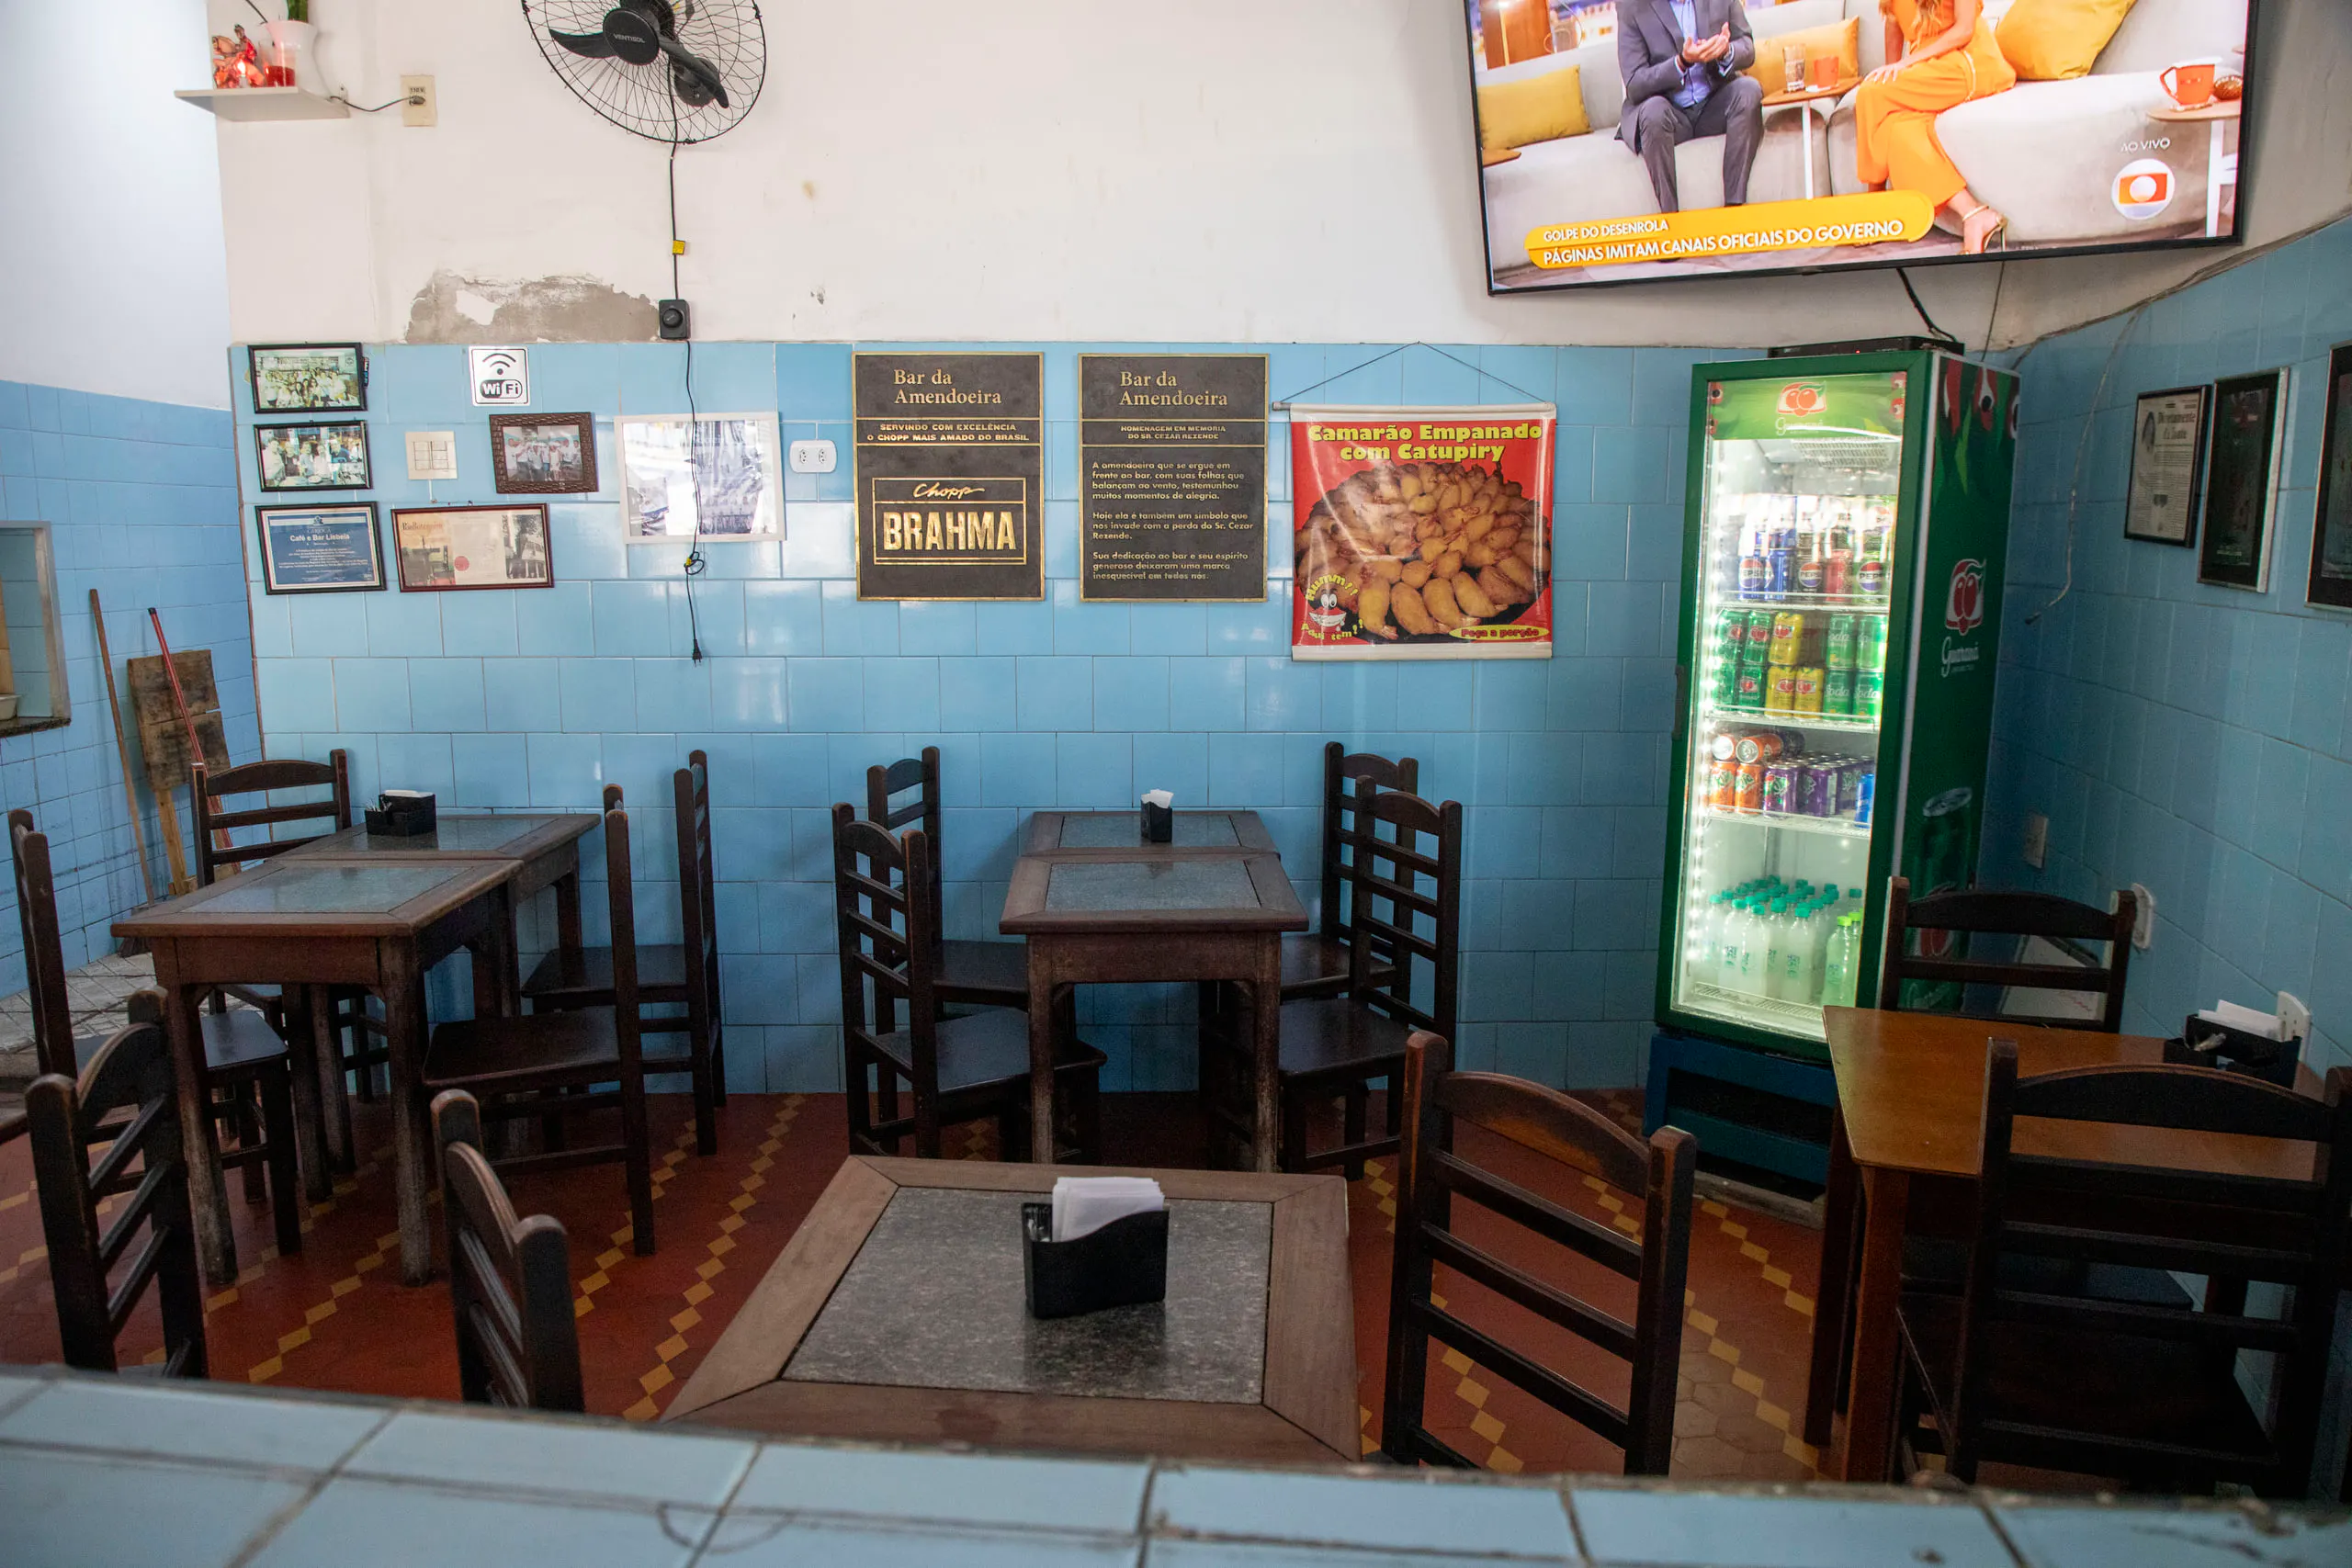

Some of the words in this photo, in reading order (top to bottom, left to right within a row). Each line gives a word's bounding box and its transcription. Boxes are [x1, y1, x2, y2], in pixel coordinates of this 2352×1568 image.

[2120, 141, 2138, 152] AO
[2140, 137, 2170, 150] VIVO
[1544, 228, 1578, 243] GOLPE
[1581, 226, 1599, 239] DO
[1600, 220, 1669, 237] DESENROLA
[1543, 245, 1604, 265] PÁGINAS
[1606, 241, 1659, 260] IMITAM
[1660, 236, 1716, 255] CANAIS
[1718, 230, 1784, 250] OFICIAIS
[1786, 227, 1814, 244] DO
[1815, 220, 1904, 242] GOVERNO
[893, 369, 925, 385] Bar
[931, 369, 953, 385] da
[1120, 371, 1151, 387] Bar
[1156, 370, 1177, 387] da
[894, 388, 1001, 404] Amendoeira
[1119, 389, 1228, 406] Amendoeira
[956, 423, 1017, 431] EXCELÊNCIA
[1307, 424, 1413, 442] Camarão
[1419, 423, 1544, 443] Empanado
[1340, 446, 1390, 461] com
[1397, 443, 1506, 462] Catupiry
[1158, 463, 1174, 471] que
[1188, 463, 1215, 471] ergue
[1092, 471, 1118, 479] frente
[1135, 471, 1152, 480] bar,
[1198, 471, 1226, 479] folhas
[1227, 473, 1245, 481] que
[912, 481, 986, 500] Chopp
[1092, 481, 1136, 491] balançam
[1152, 482, 1180, 491] vento,
[1182, 481, 1238, 490] testemunhou
[1092, 491, 1122, 500] muitos
[1124, 491, 1170, 500] momentos
[1172, 491, 1184, 500] de
[1186, 491, 1220, 501] alegria.
[1092, 513, 1113, 521] Hoje
[1114, 512, 1129, 520] ela
[1131, 512, 1137, 520] é
[1138, 512, 1175, 520] também
[883, 511, 1017, 551] BRAHMA
[1110, 522, 1141, 530] invade
[1171, 522, 1199, 531] perda
[1201, 522, 1213, 530] do
[1215, 522, 1227, 530] Sr.
[1228, 522, 1254, 530] Cezar
[289, 534, 306, 542] Café
[1092, 532, 1133, 540] Rezende.
[1112, 552, 1156, 561] dedicação
[1215, 552, 1249, 561] espírito
[1092, 563, 1135, 571] generoso
[1136, 561, 1179, 570] deixaram
[1092, 571, 1146, 581] inesquecível
[1301, 622, 1325, 640] Aqui
[1461, 629, 1488, 638] Peça
[1499, 627, 1540, 638] porção
